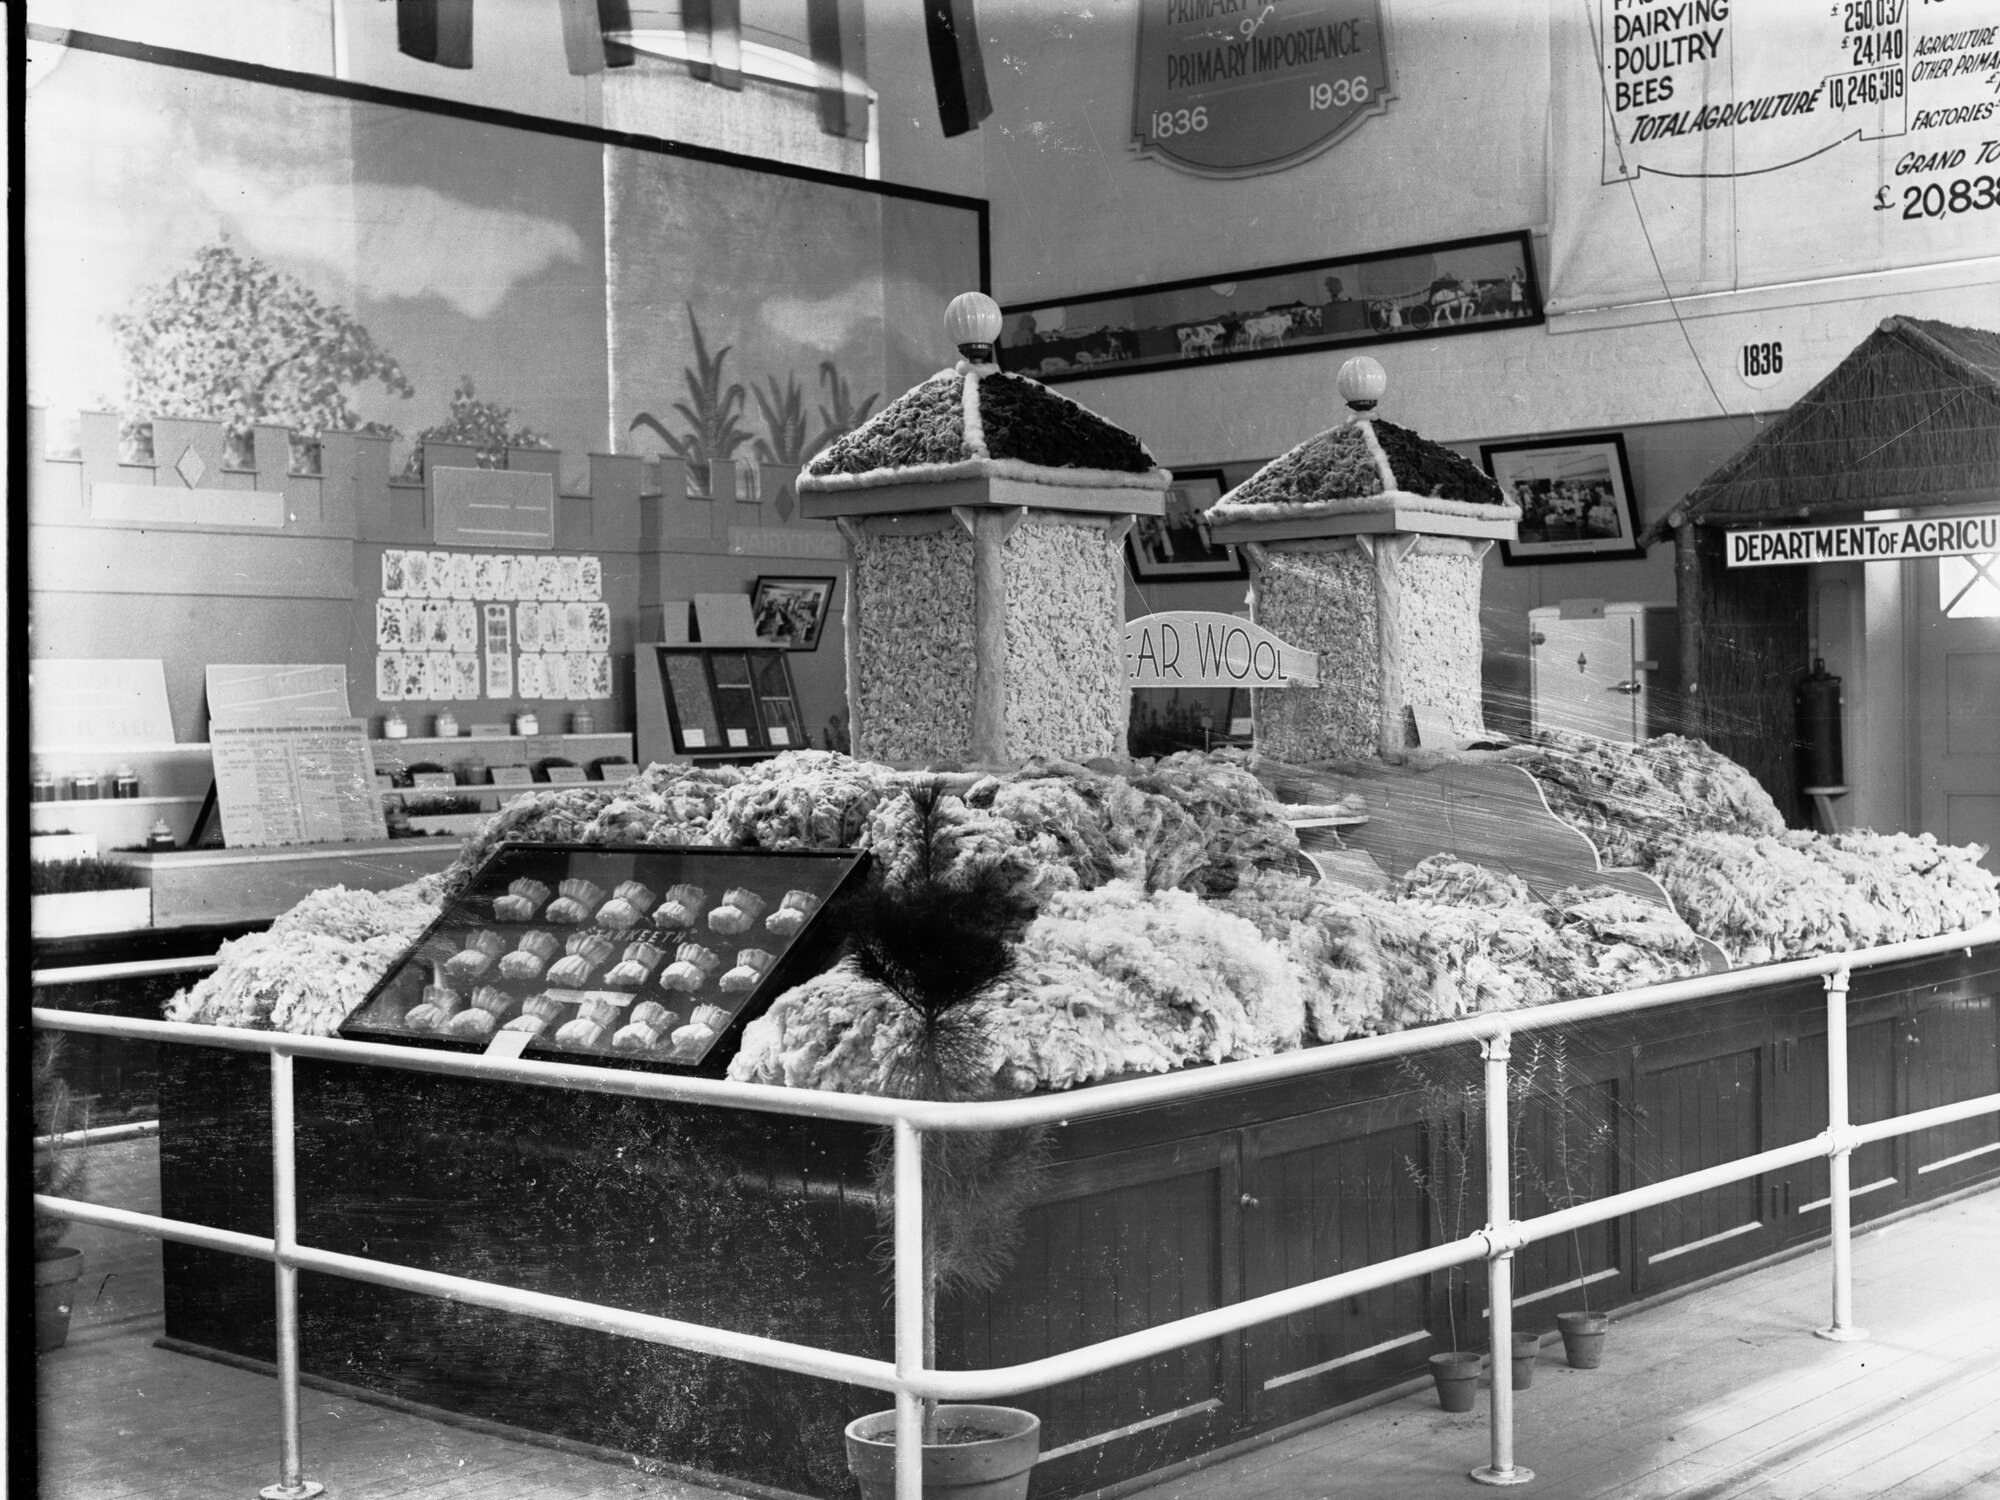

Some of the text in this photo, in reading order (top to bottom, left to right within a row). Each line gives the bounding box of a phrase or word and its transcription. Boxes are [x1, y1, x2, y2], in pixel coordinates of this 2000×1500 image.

[1614, 0, 1729, 43] DAIRYING
[1167, 18, 1360, 90] PRIMARY IMPORTANCE
[1614, 28, 1724, 79] POULTRY
[1912, 26, 1999, 58] AGRICULTURE
[1911, 50, 2000, 82] OTHER PRIMA
[1309, 76, 1370, 111] 1936
[1615, 75, 1674, 112] BEES
[1151, 106, 1209, 139] 1836
[1629, 110, 1691, 144] TOTAL
[1687, 88, 1823, 134] AGRICULTURE
[1911, 102, 1995, 131] FACTORIES
[1894, 149, 1967, 176] GRAND
[1743, 341, 1783, 377] 1836
[1734, 519, 1997, 562] DEPARTMENT OF AGRICU
[1125, 621, 1288, 680] AR WOOL
